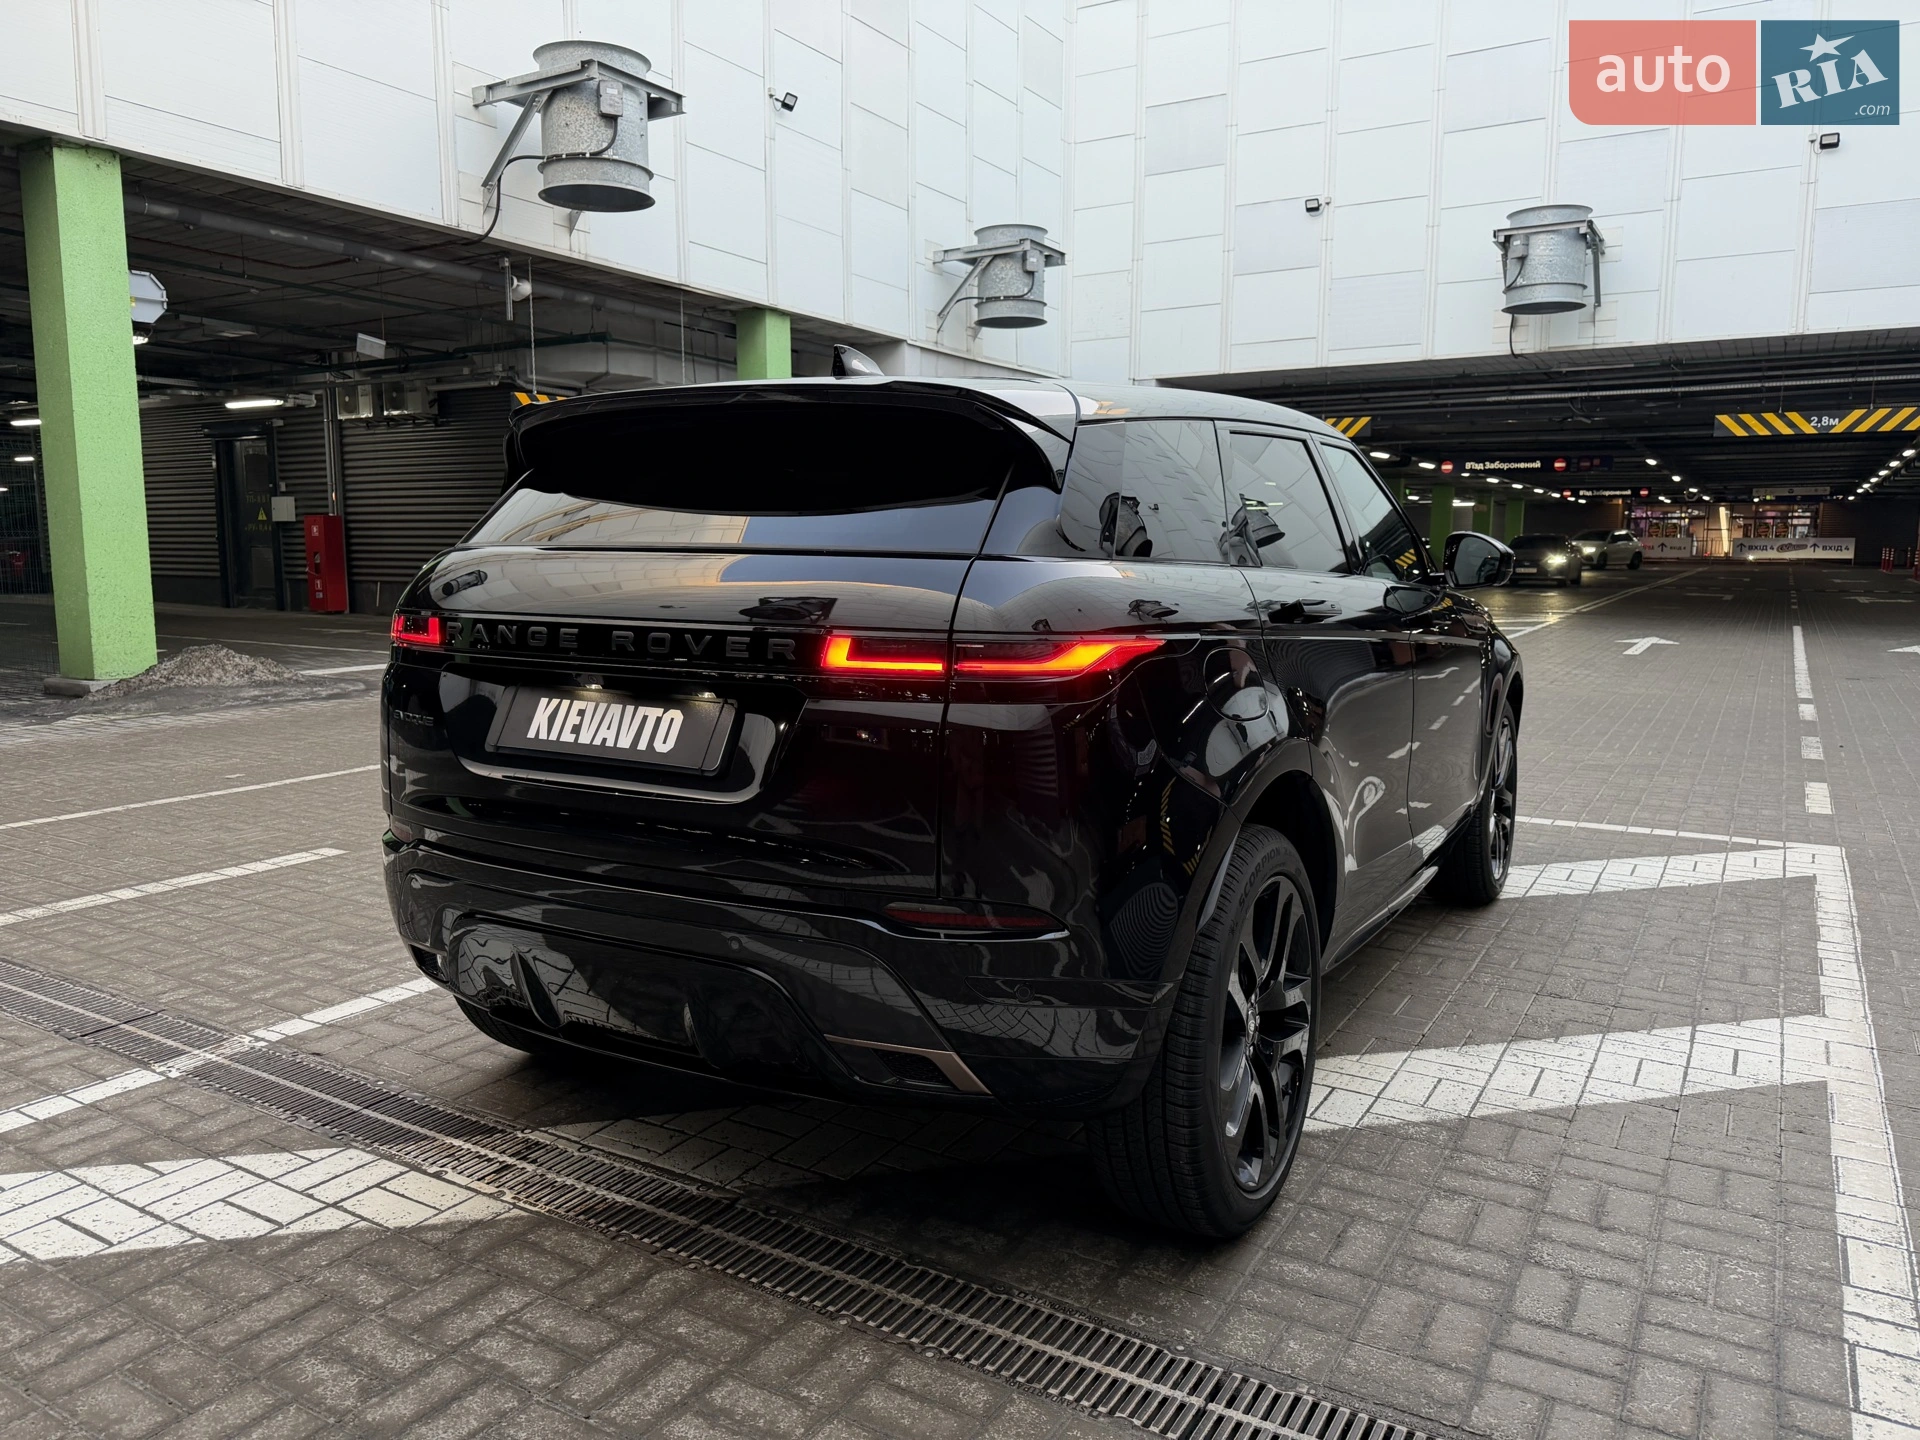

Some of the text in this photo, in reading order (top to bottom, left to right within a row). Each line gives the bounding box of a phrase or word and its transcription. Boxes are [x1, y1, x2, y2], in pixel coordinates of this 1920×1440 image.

[1485, 460, 1541, 471] Заборонений
[1748, 544, 1768, 552] ВХІД
[1822, 544, 1843, 552] ВХІД
[446, 621, 796, 660] RANGE ROVER
[526, 697, 684, 754] KIEVAVTO
[1238, 846, 1281, 908] SCORPION
